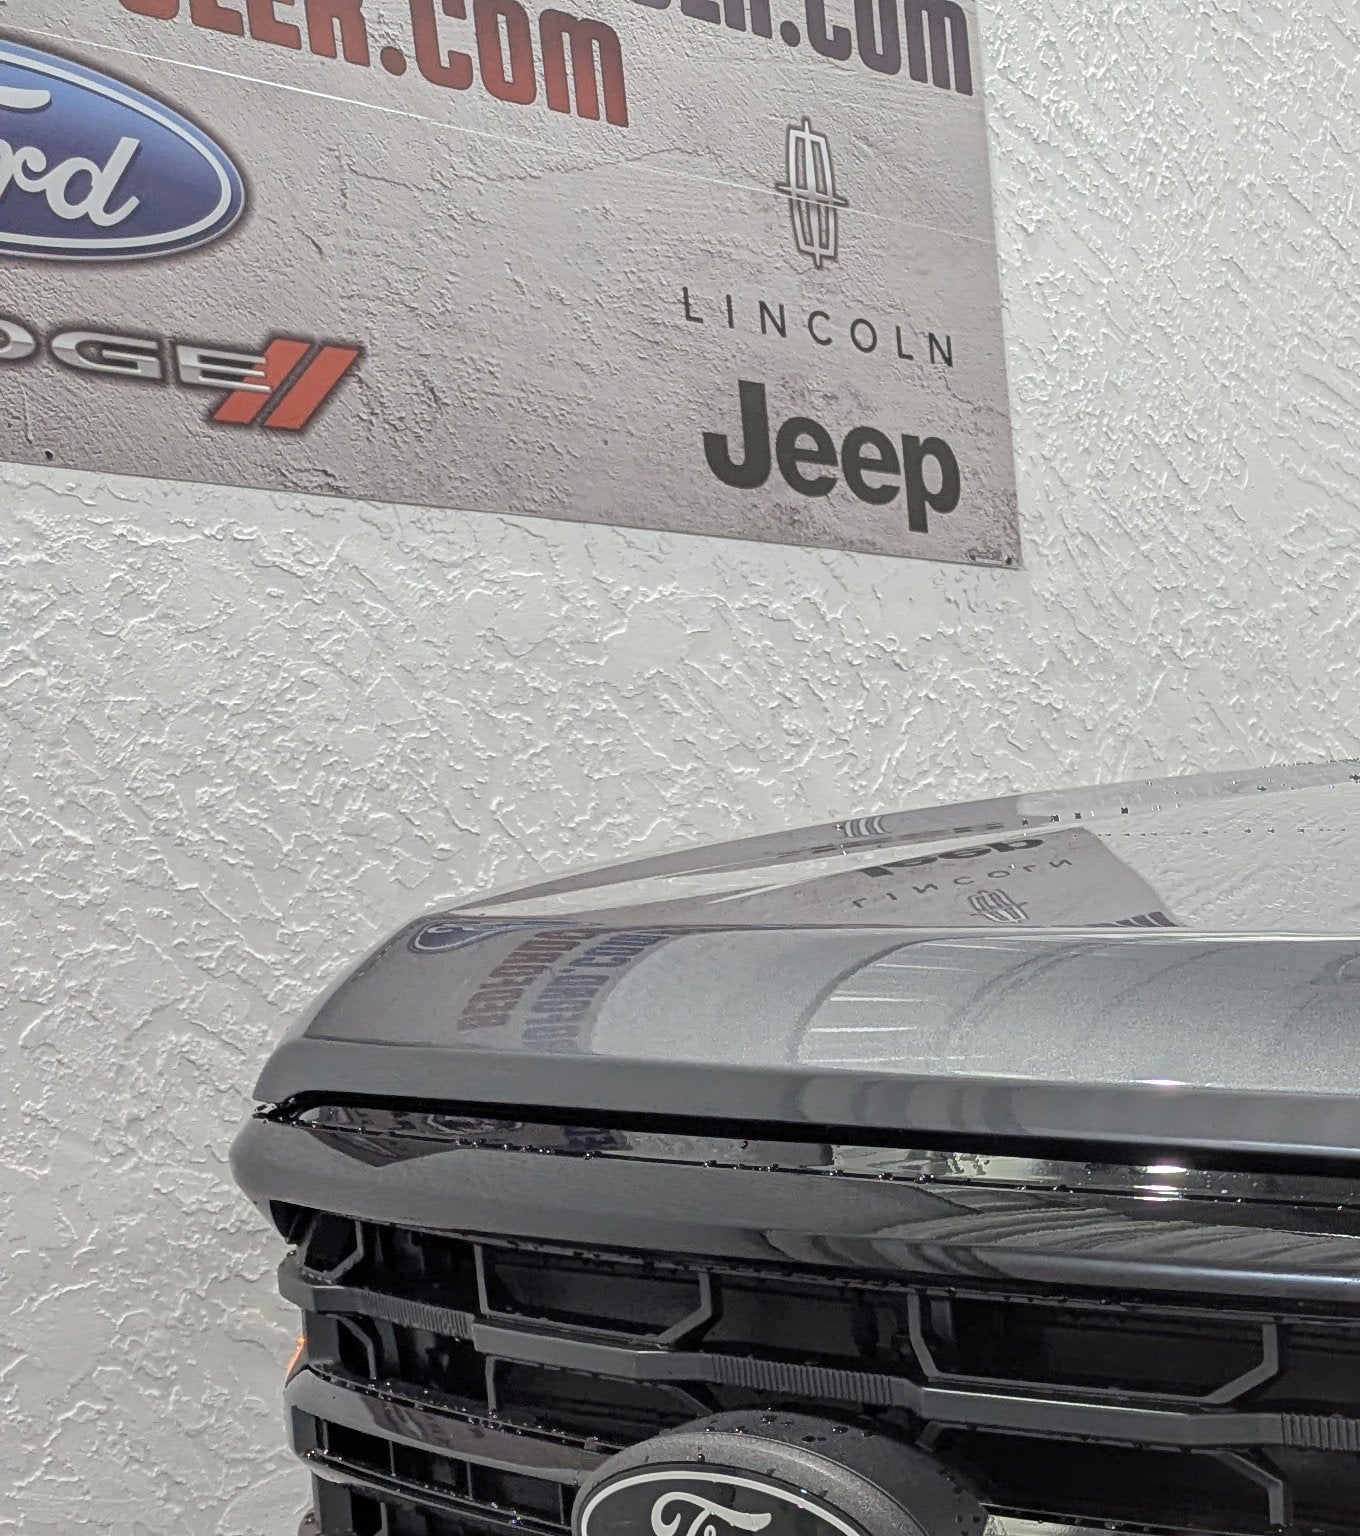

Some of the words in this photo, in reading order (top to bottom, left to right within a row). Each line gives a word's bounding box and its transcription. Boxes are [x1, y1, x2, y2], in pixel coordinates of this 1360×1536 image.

[0, 86, 141, 227] rd
[682, 286, 954, 368] LINCOLN
[701, 379, 961, 534] Jeep
